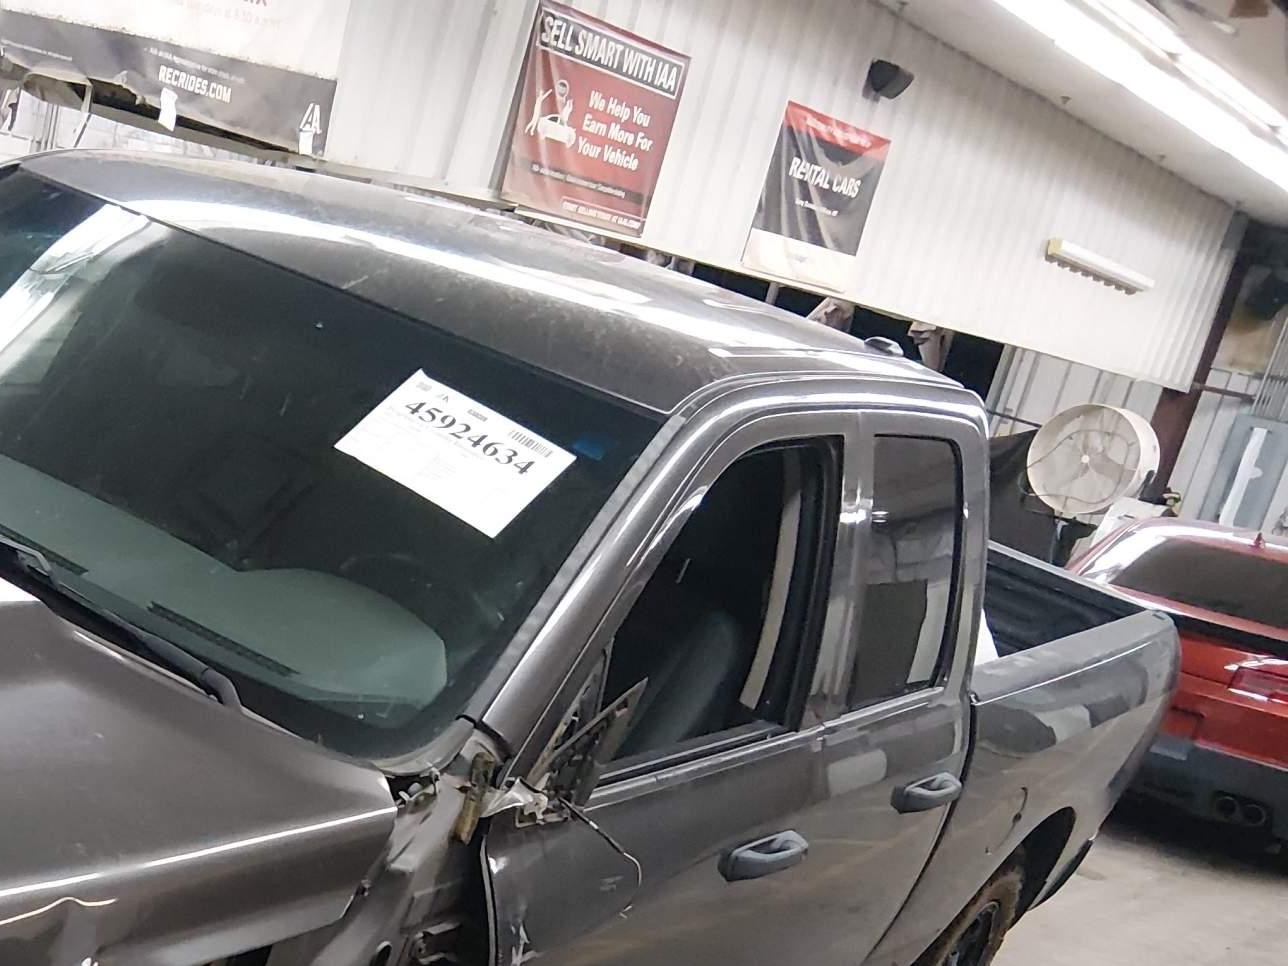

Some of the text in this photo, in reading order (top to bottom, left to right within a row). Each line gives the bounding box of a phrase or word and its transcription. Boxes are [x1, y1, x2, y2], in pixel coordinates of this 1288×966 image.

[540, 16, 678, 92] SELL SMART WITH IAA
[158, 64, 232, 104] RECRIDES.COM
[588, 90, 651, 127] We Help You
[582, 113, 653, 152] Earn More For
[577, 135, 640, 171] Your Vehicle
[788, 156, 861, 198] RENTAL CARS
[404, 399, 536, 475] 45924634
